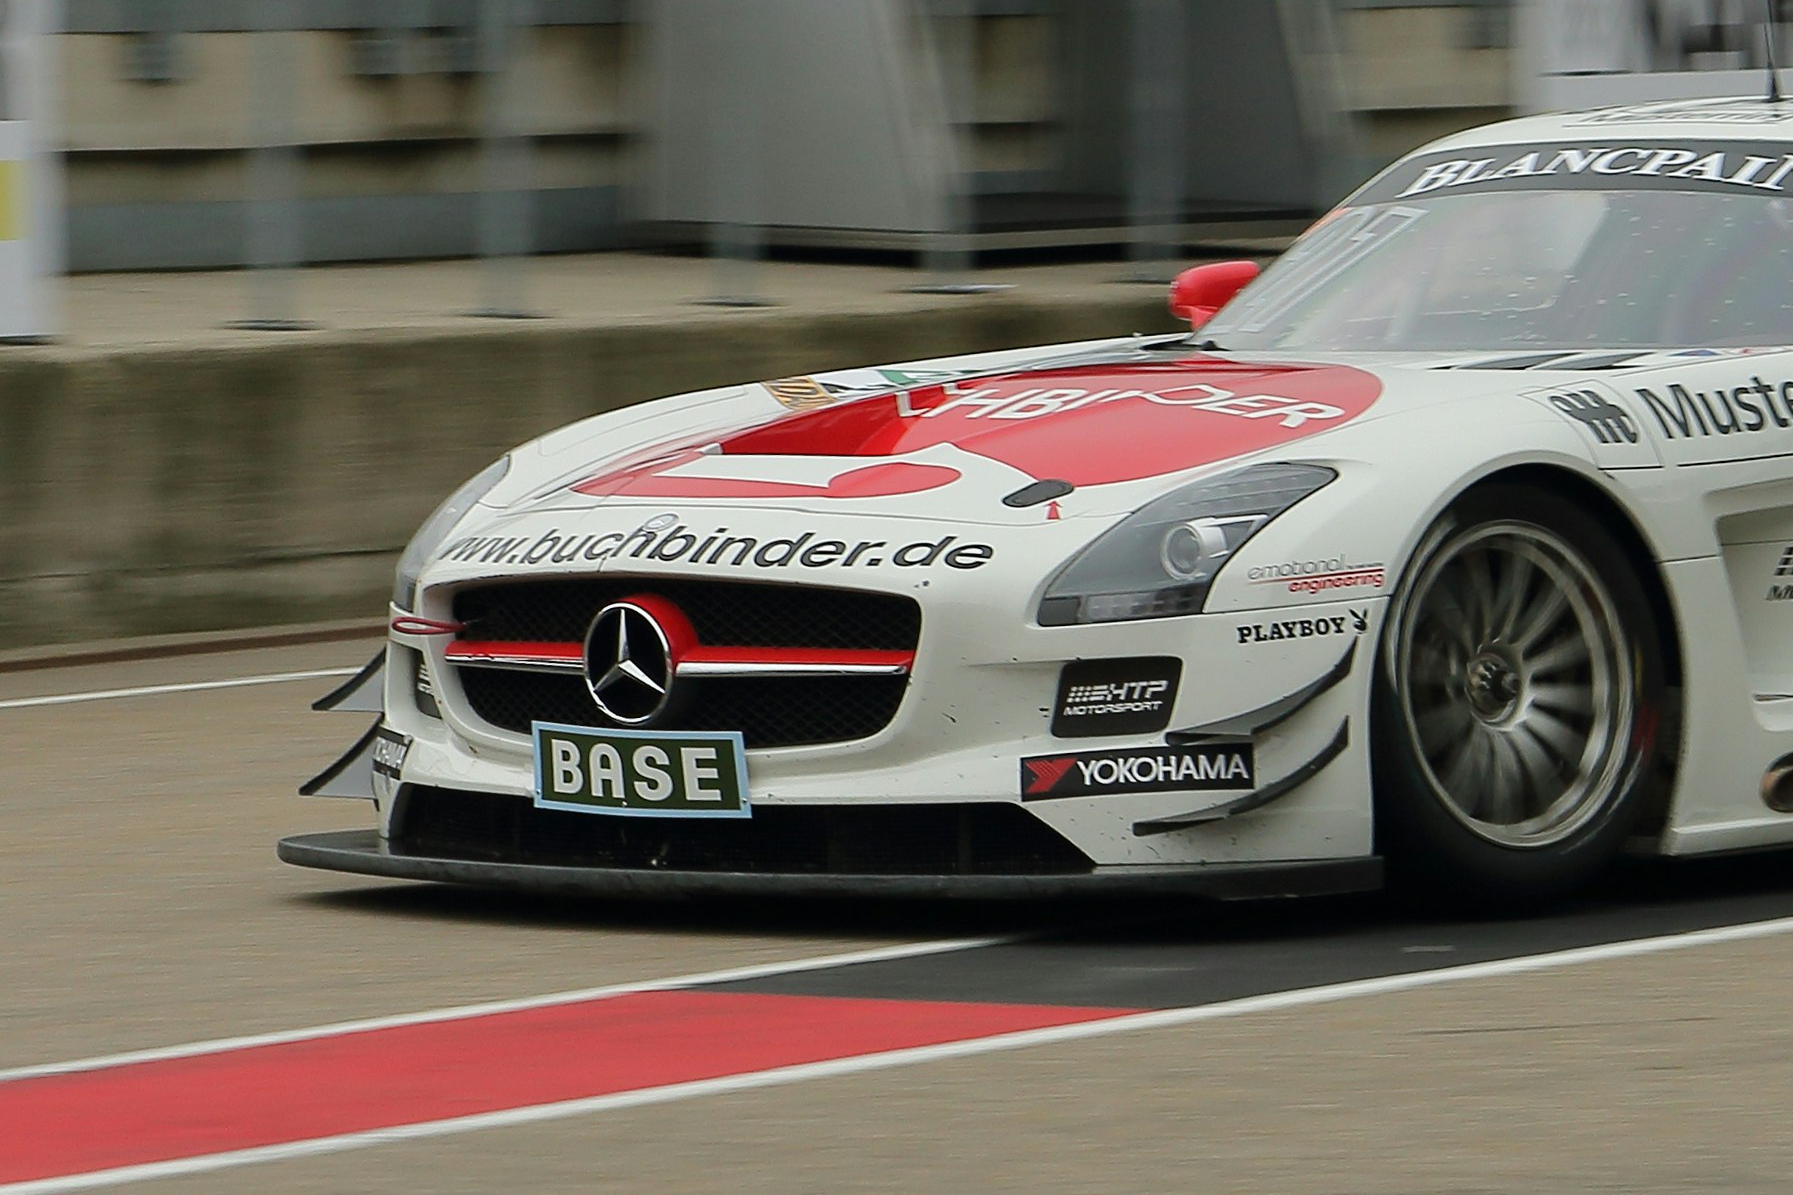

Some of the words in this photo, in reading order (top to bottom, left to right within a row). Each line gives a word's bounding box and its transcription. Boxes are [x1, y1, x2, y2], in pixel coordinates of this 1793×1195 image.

[437, 523, 993, 571] www.buchbinder.de
[1247, 554, 1345, 579] emotional
[1288, 573, 1384, 595] engineering
[1237, 616, 1346, 644] PLAYBOY
[1063, 700, 1163, 716] MOTORSPORT
[551, 738, 723, 803] BASE
[1076, 753, 1249, 786] YOKOHAMA
